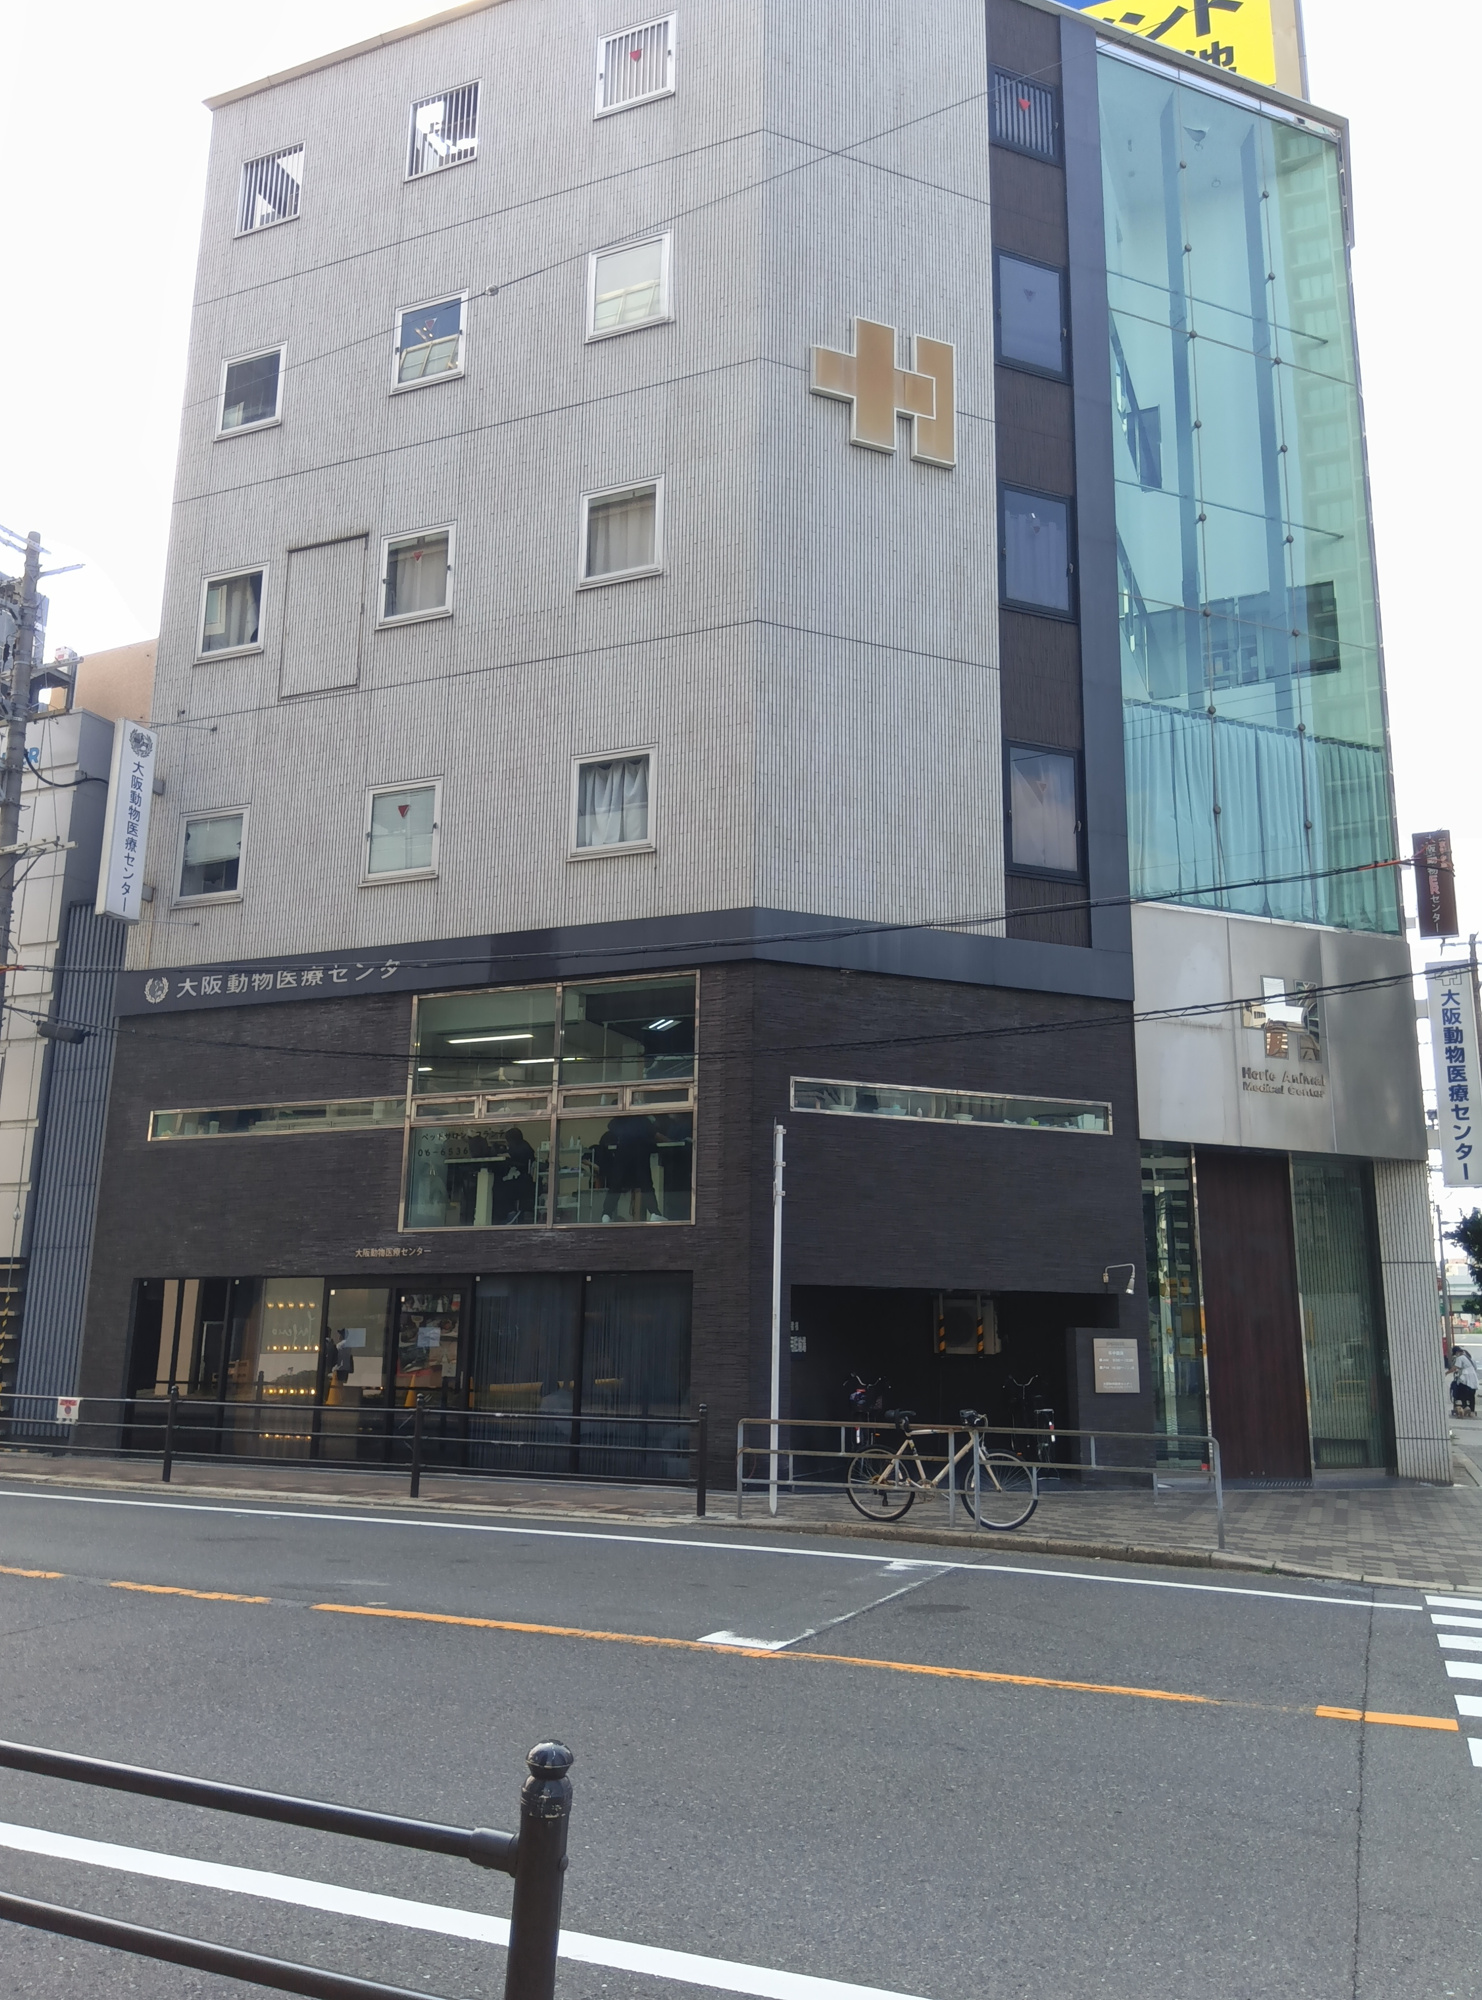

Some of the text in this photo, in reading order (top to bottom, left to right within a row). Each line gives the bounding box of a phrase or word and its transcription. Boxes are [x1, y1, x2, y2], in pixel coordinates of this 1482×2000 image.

[121, 761, 145, 912] 大阪動物医療センター
[176, 958, 421, 999] 大阪動物医療センタ
[1242, 1081, 1285, 1095] Medical
[1441, 989, 1473, 1180] 大阪動物医療センター
[355, 1247, 432, 1258] 大阪動物医療センター
